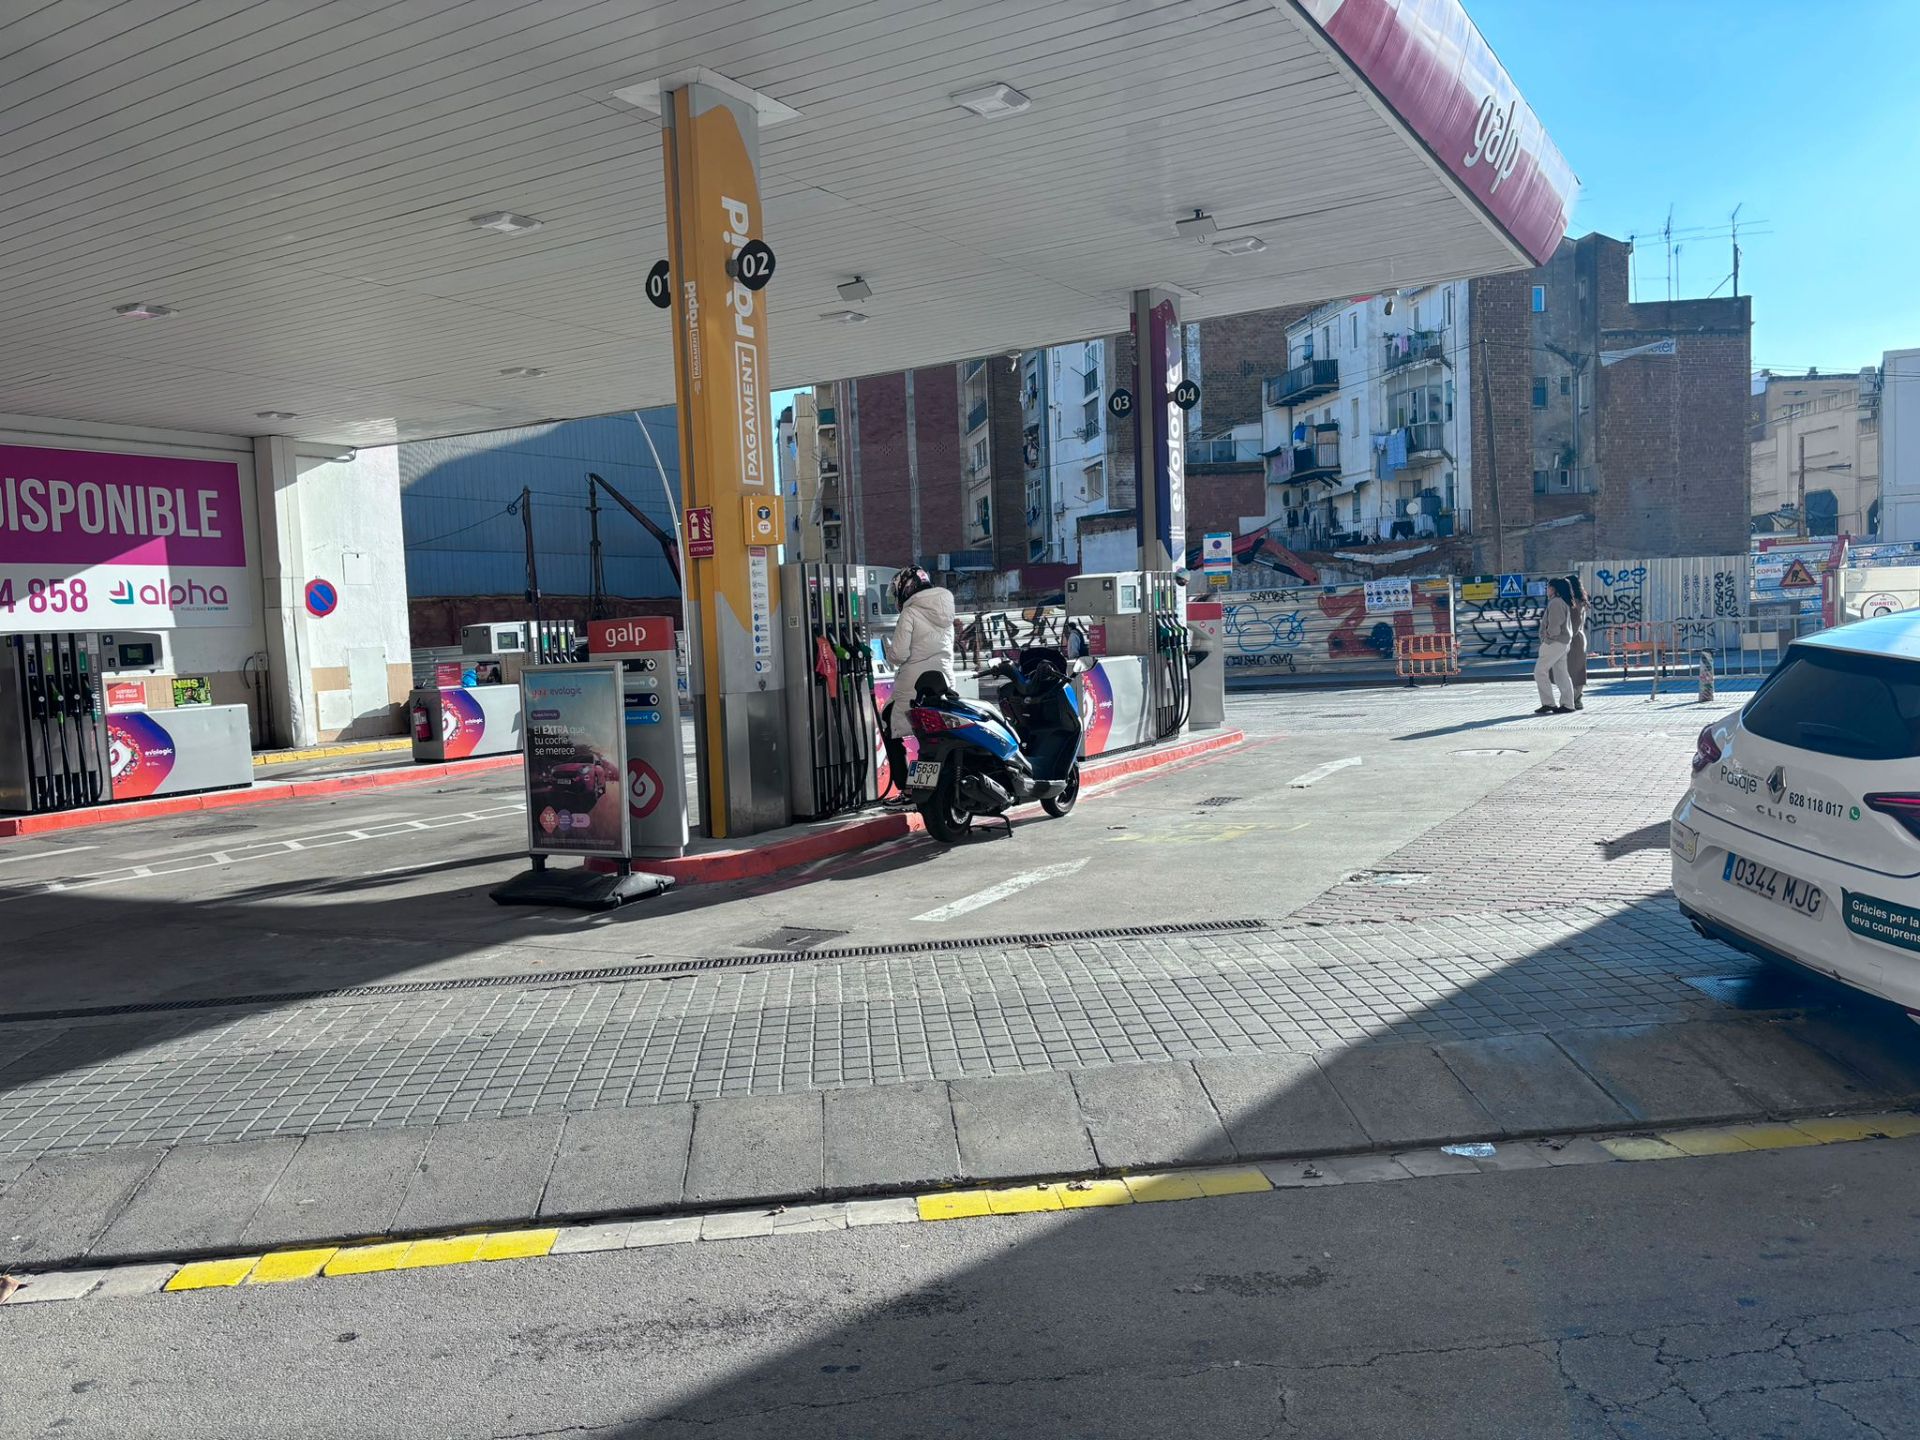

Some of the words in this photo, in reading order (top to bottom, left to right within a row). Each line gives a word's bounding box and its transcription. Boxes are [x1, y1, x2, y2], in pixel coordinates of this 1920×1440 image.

[1463, 94, 1521, 195] galp
[721, 196, 756, 339] ràid
[743, 252, 769, 278] 02
[1113, 396, 1130, 411] 03
[1177, 387, 1195, 402] 04
[741, 351, 758, 477] PAGAMENT
[28, 578, 89, 613] 858
[139, 578, 228, 611] alpha
[605, 622, 647, 648] galp
[534, 726, 541, 735] El
[542, 725, 569, 736] EXTRA
[569, 726, 585, 737] que
[535, 737, 544, 745] tu
[545, 735, 569, 745] coche
[535, 748, 545, 756] se
[545, 747, 576, 756] merece
[913, 773, 931, 785] JLY
[916, 763, 939, 774] 5630
[1720, 765, 1757, 794] Pasaje
[1789, 792, 1805, 808] 628
[1807, 796, 1823, 813] 118
[1825, 801, 1844, 818] 017
[1734, 858, 1776, 896] 0344
[1782, 877, 1821, 913] MJG
[1851, 914, 1870, 928] teva
[1852, 899, 1888, 919] Gràcies
[1889, 913, 1907, 924] per
[1909, 916, 1920, 928] la
